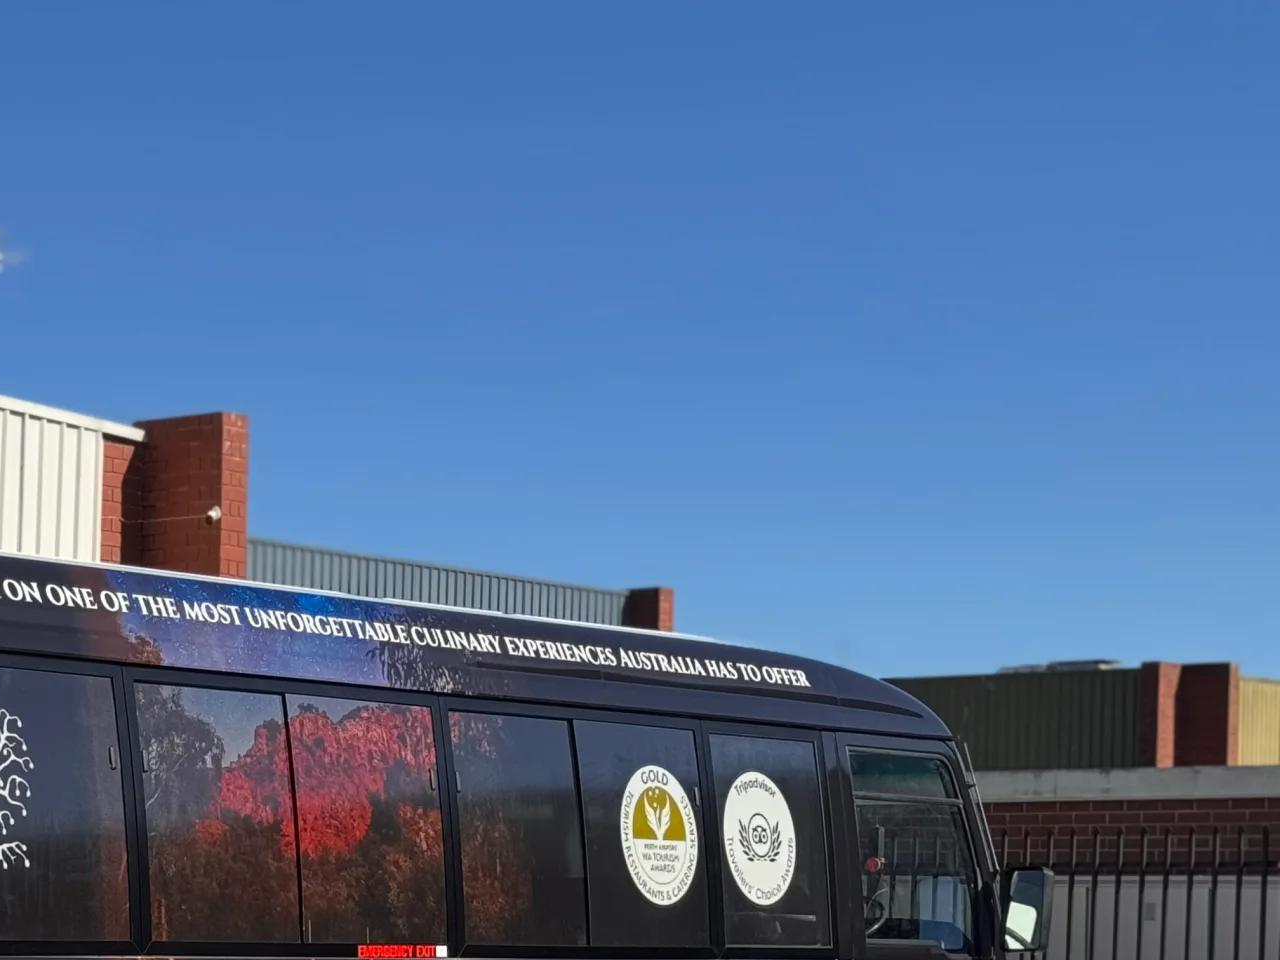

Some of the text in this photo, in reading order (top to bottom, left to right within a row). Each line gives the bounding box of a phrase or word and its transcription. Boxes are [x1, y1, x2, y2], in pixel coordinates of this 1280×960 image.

[2, 578, 43, 604] ON
[45, 583, 98, 610] ONE
[100, 589, 130, 613] OF
[132, 593, 181, 619] THE
[181, 599, 242, 627] MOST
[244, 606, 410, 645] UNFORGETTABLE
[410, 625, 502, 655] CULINARY
[504, 635, 617, 667] EXPERIENCES
[619, 646, 705, 677] AUSTRALIA
[705, 658, 738, 680] HAS
[738, 662, 761, 683] TO
[763, 665, 811, 689] OFFER
[641, 769, 669, 786] GOLD
[733, 778, 777, 799] Tripadvisor
[623, 790, 635, 842] TOURISM
[680, 795, 697, 849] SERVICES
[625, 845, 665, 901] RESTAURANTS
[641, 851, 680, 863] WA TOURISM
[650, 863, 676, 873] AWARDS
[672, 853, 697, 898] CATERING
[755, 884, 782, 901] Choice
[780, 837, 794, 886] Awards
[357, 944, 436, 958] EMERGENCY EXIT
